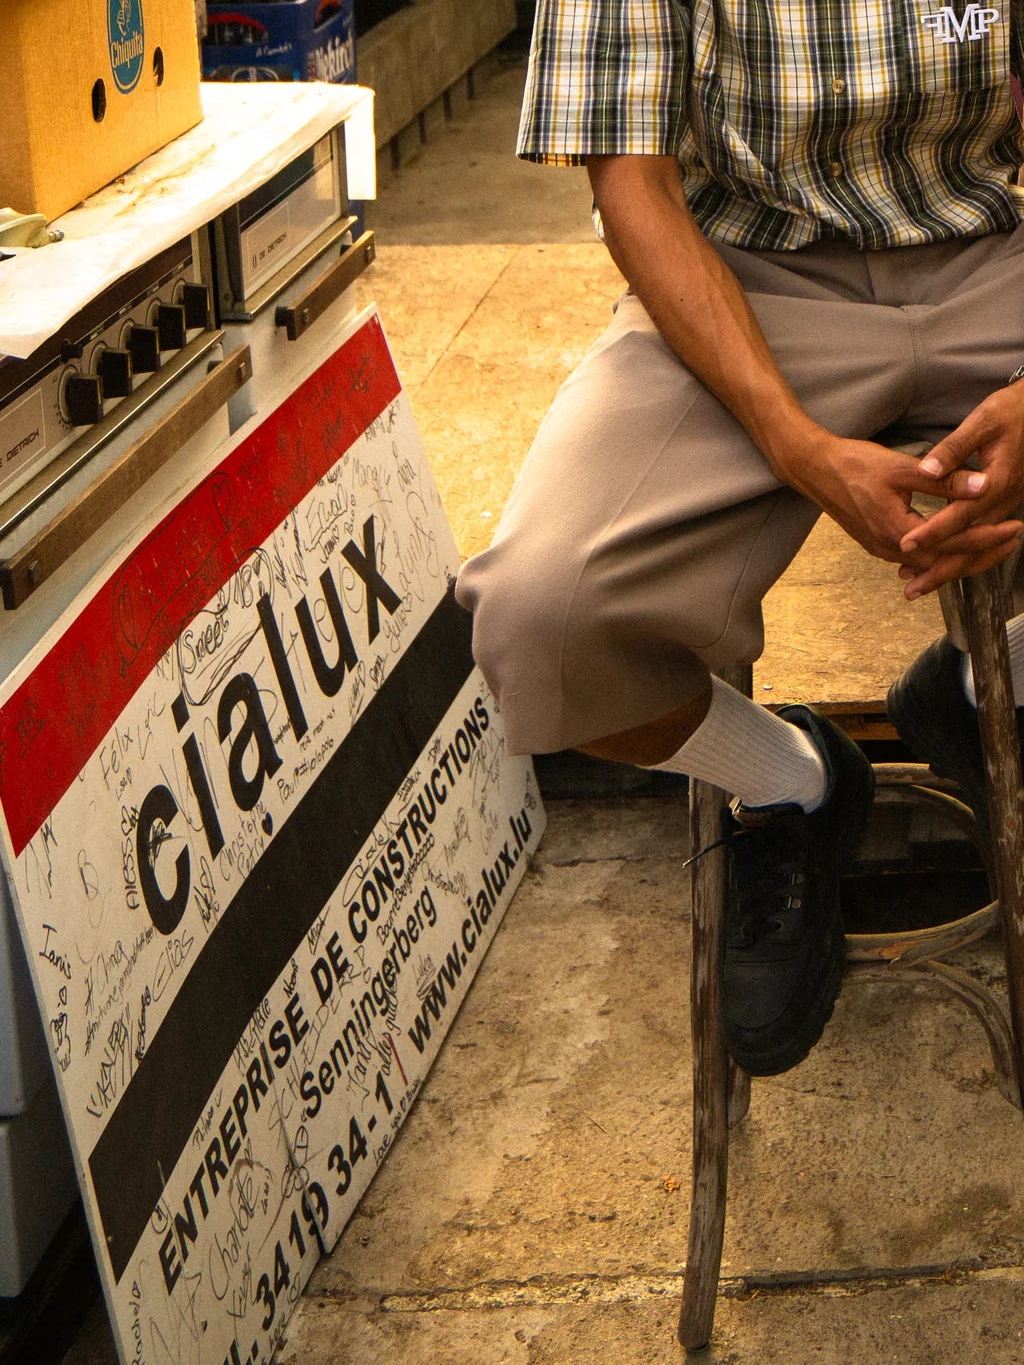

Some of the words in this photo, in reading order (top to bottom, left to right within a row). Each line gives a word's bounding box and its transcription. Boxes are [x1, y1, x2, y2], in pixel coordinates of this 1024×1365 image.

[111, 30, 143, 69] Chiquita
[6, 428, 39, 462] DIETRICH
[100, 726, 133, 790] Félix
[137, 514, 403, 935] cialux
[153, 930, 194, 1002] Elias
[159, 993, 310, 1296] ENTREPRISE
[311, 931, 349, 1006] DE
[349, 697, 489, 944] CONSTRUCTIONS
[300, 886, 437, 1119] Senningerberg
[407, 808, 533, 1054] www.cialux.lu
